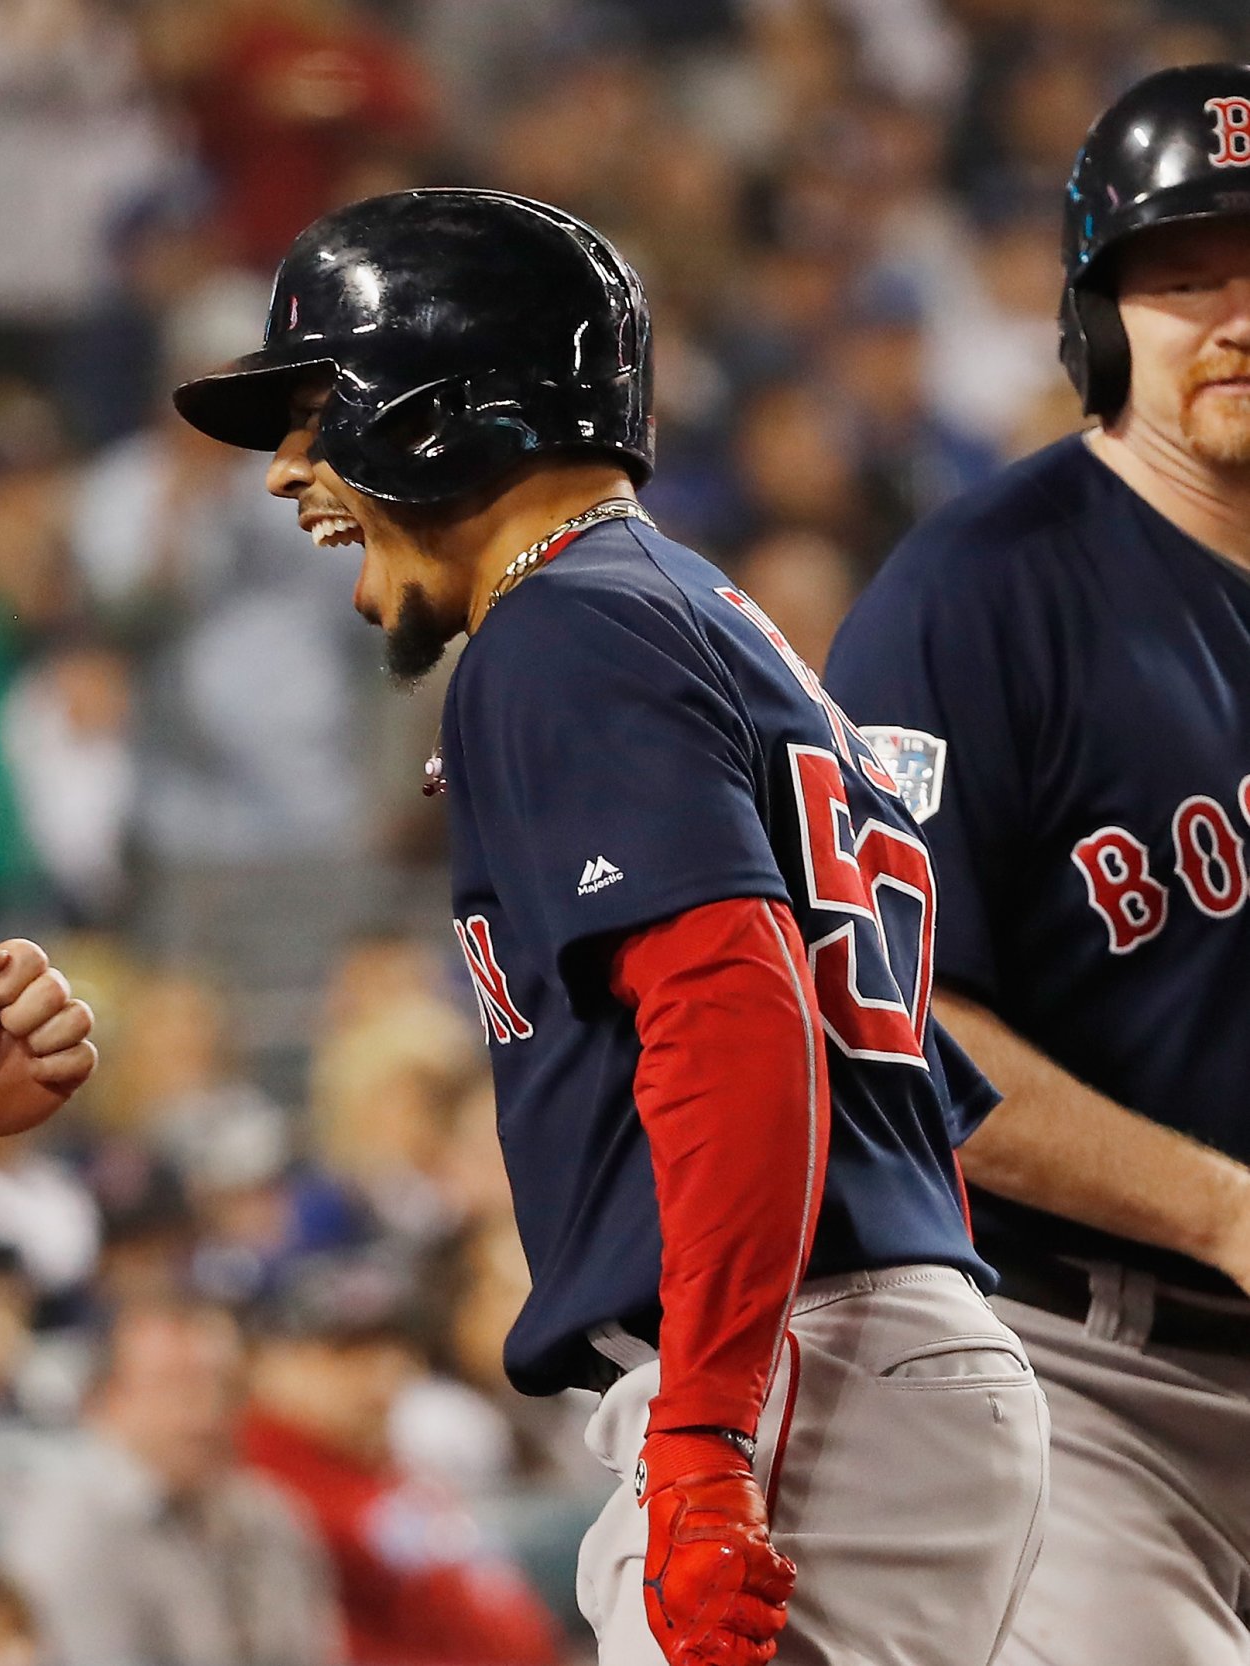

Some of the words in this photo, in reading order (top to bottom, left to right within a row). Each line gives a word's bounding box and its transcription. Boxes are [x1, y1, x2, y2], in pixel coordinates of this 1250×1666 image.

[1204, 96, 1250, 168] B
[577, 872, 624, 896] Majestic
[786, 742, 937, 1071] 50
[1071, 774, 1250, 954] BO
